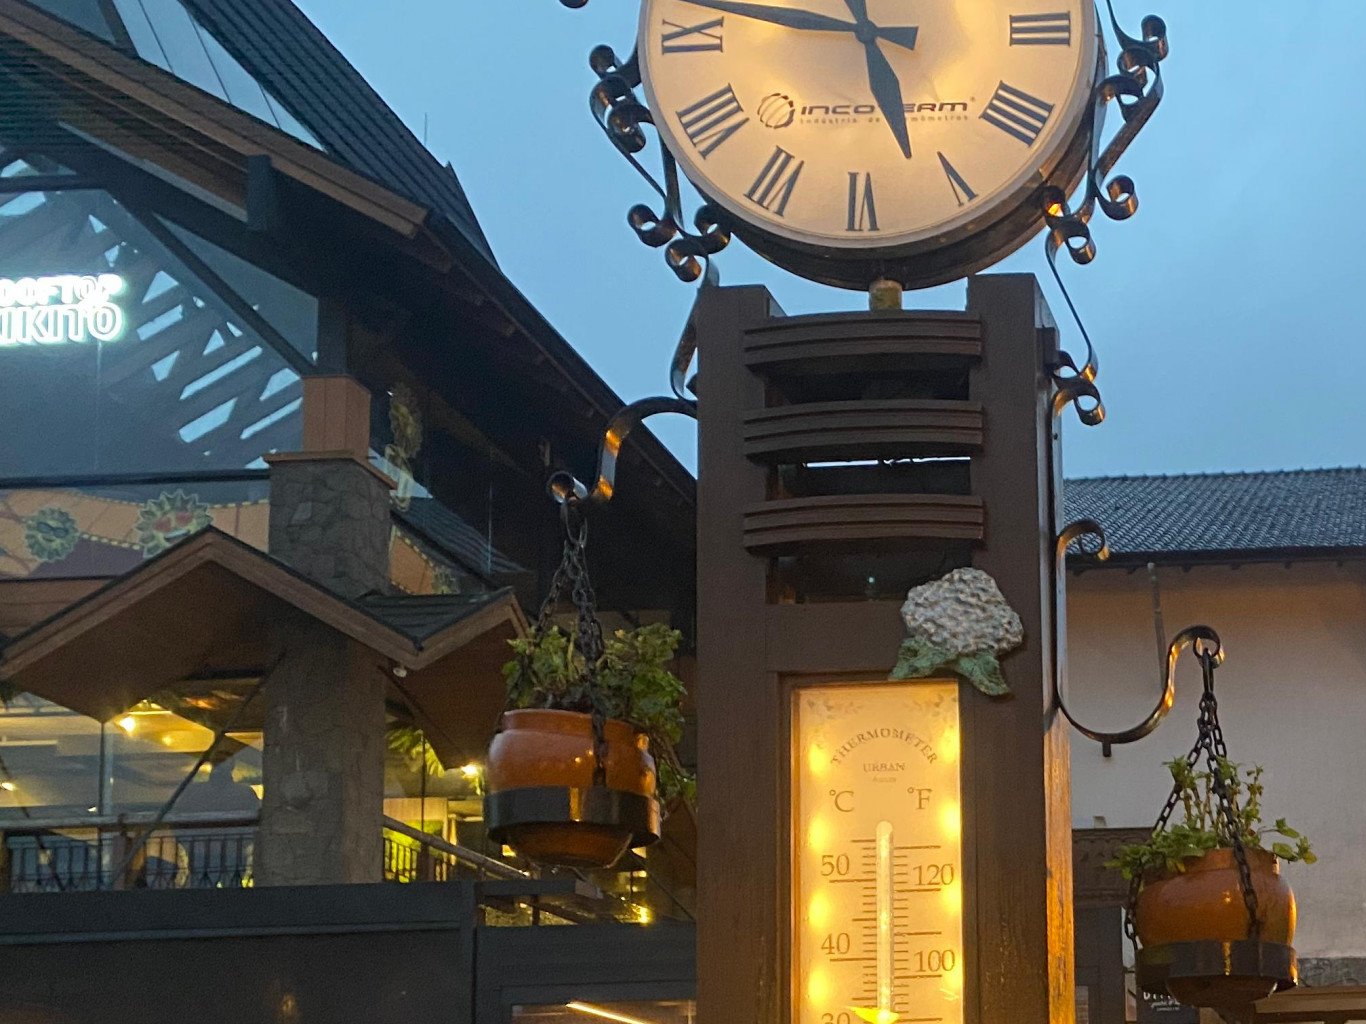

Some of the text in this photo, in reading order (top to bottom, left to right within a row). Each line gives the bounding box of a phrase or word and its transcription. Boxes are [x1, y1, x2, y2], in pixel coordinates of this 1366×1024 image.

[1009, 11, 1071, 47] III
[801, 102, 968, 116] INCOERM
[830, 728, 938, 764] THERMOMETER
[863, 762, 905, 773] URBAN
[821, 853, 850, 877] 50
[913, 863, 954, 887] 120
[821, 932, 851, 955] 40
[915, 949, 956, 973] 100
